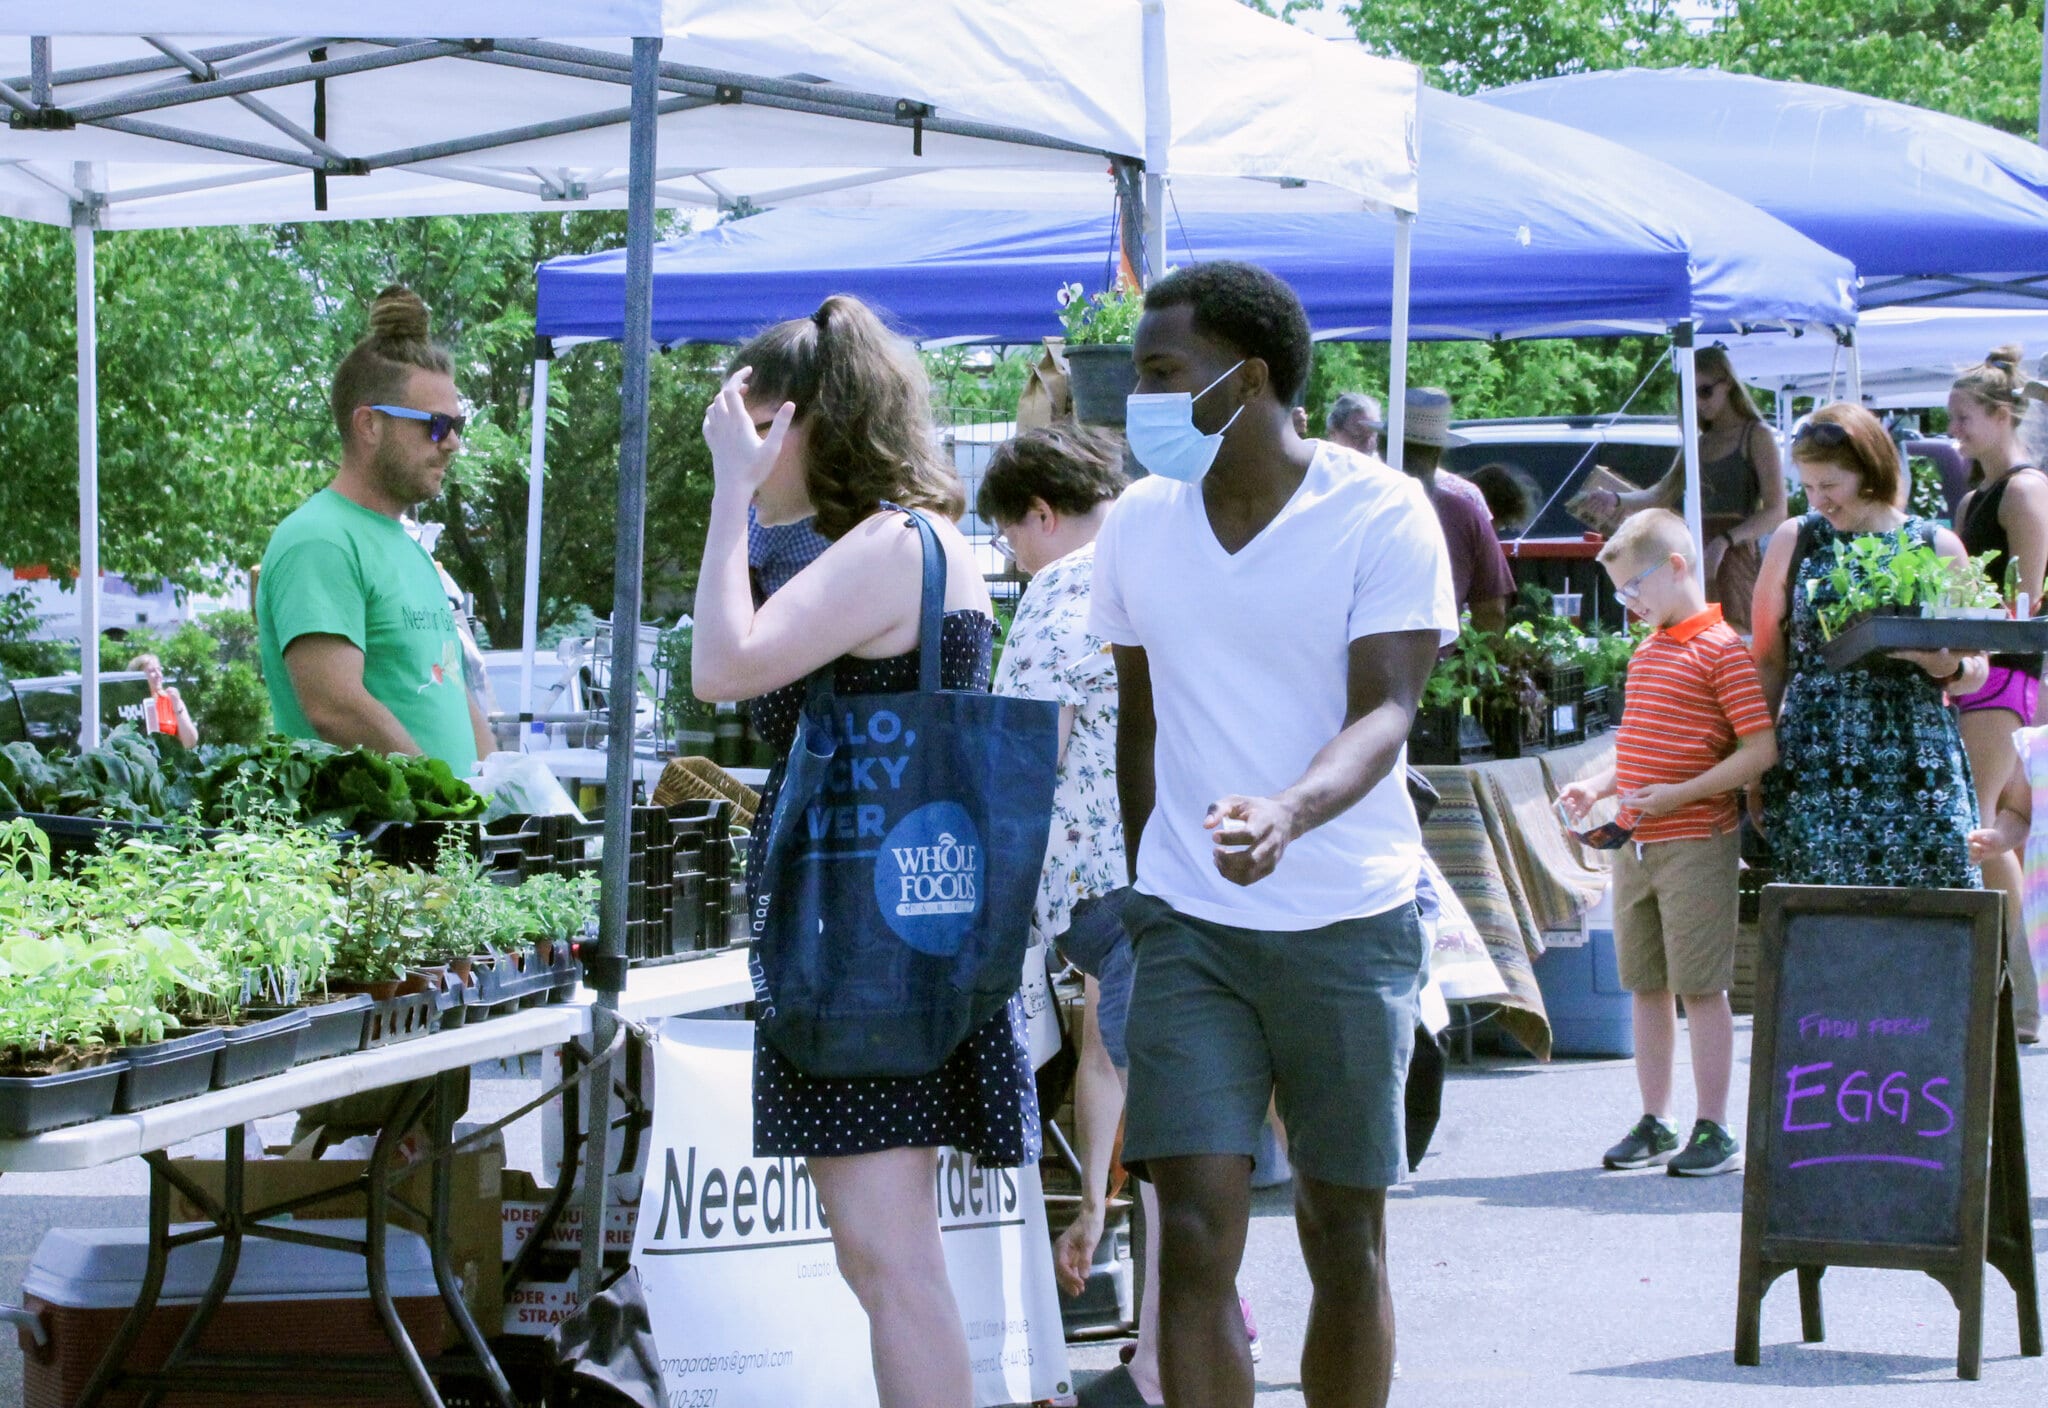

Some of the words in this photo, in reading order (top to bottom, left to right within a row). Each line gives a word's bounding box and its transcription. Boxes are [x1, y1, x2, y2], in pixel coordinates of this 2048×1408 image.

[891, 845, 976, 874] WHOLE
[899, 873, 976, 902] FOODS
[1783, 1061, 1955, 1137] EGGS
